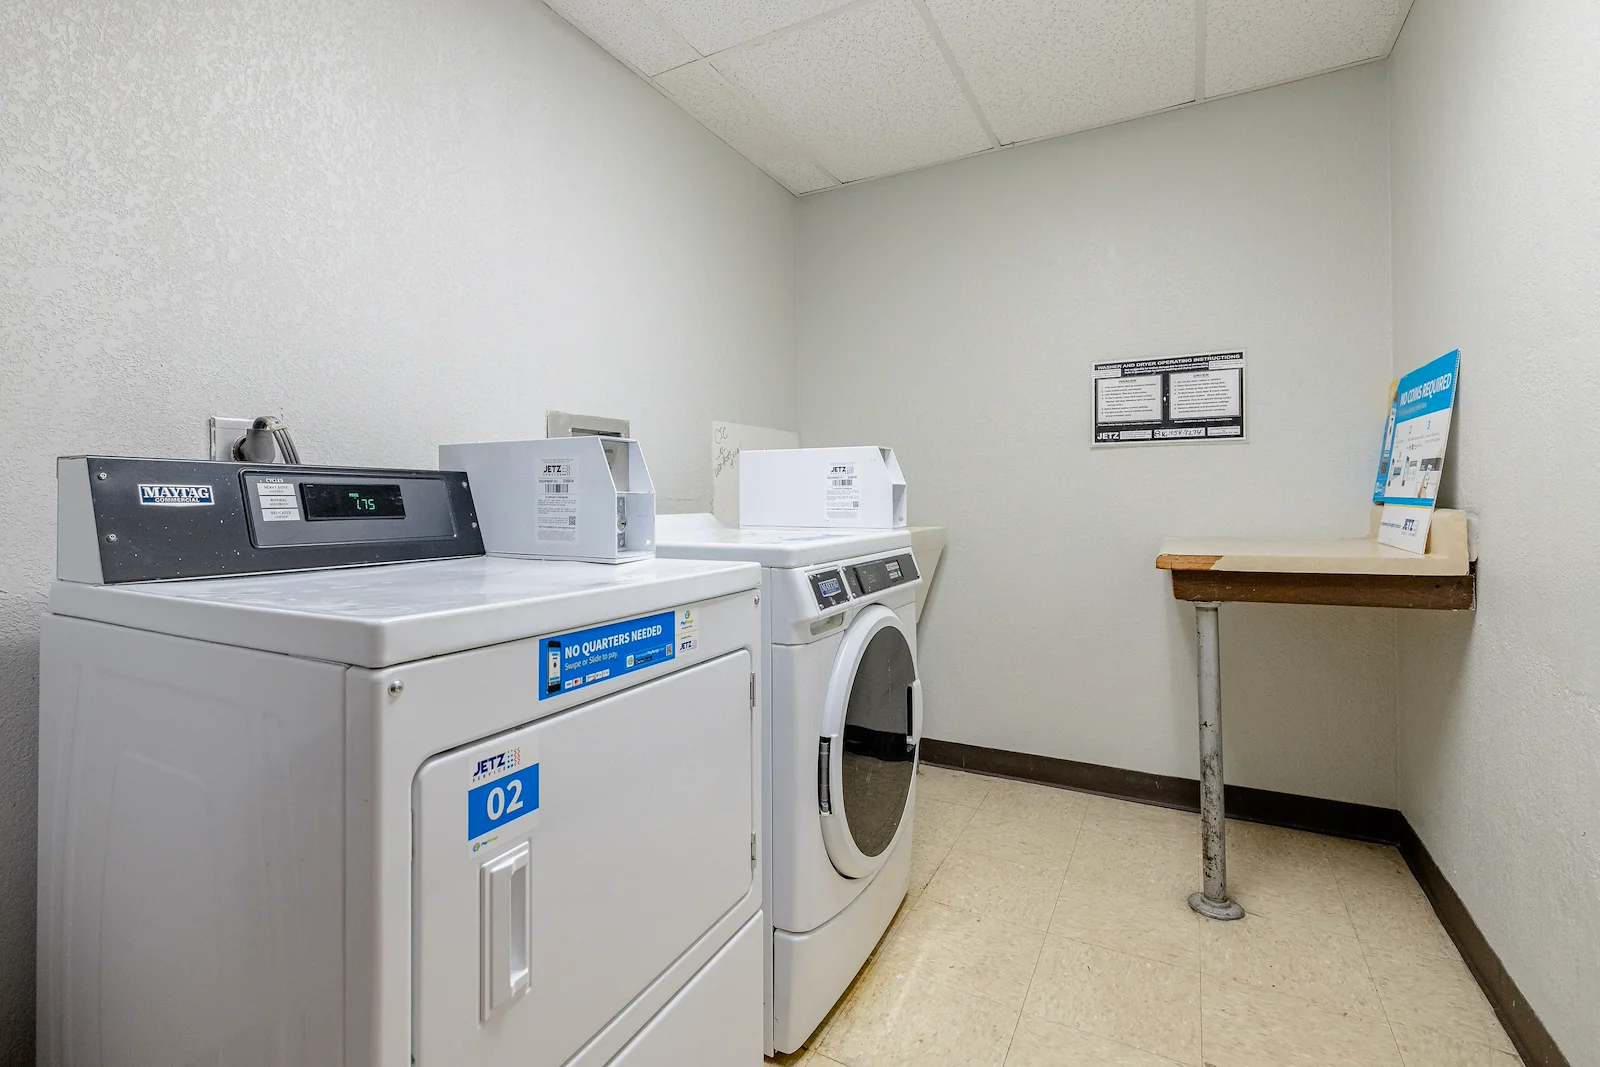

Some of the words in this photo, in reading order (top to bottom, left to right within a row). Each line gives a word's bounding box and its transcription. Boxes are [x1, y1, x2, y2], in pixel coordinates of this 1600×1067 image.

[1193, 354, 1240, 362] INSTRUCTIONS
[1400, 391, 1408, 407] NO
[1422, 372, 1452, 399] REQUIRED
[1097, 432, 1119, 440] JETZ
[544, 465, 562, 473] JETZ
[142, 487, 209, 498] MAYTAG
[565, 644, 580, 659] NO
[582, 632, 630, 656] QUARTERS
[632, 625, 662, 642] NEEDED
[680, 640, 692, 651] JETZ
[565, 660, 581, 671] Swipe
[589, 654, 602, 664] Slide
[472, 752, 506, 777] JETZ
[472, 766, 506, 783] SERVICE
[487, 779, 524, 821] 02
